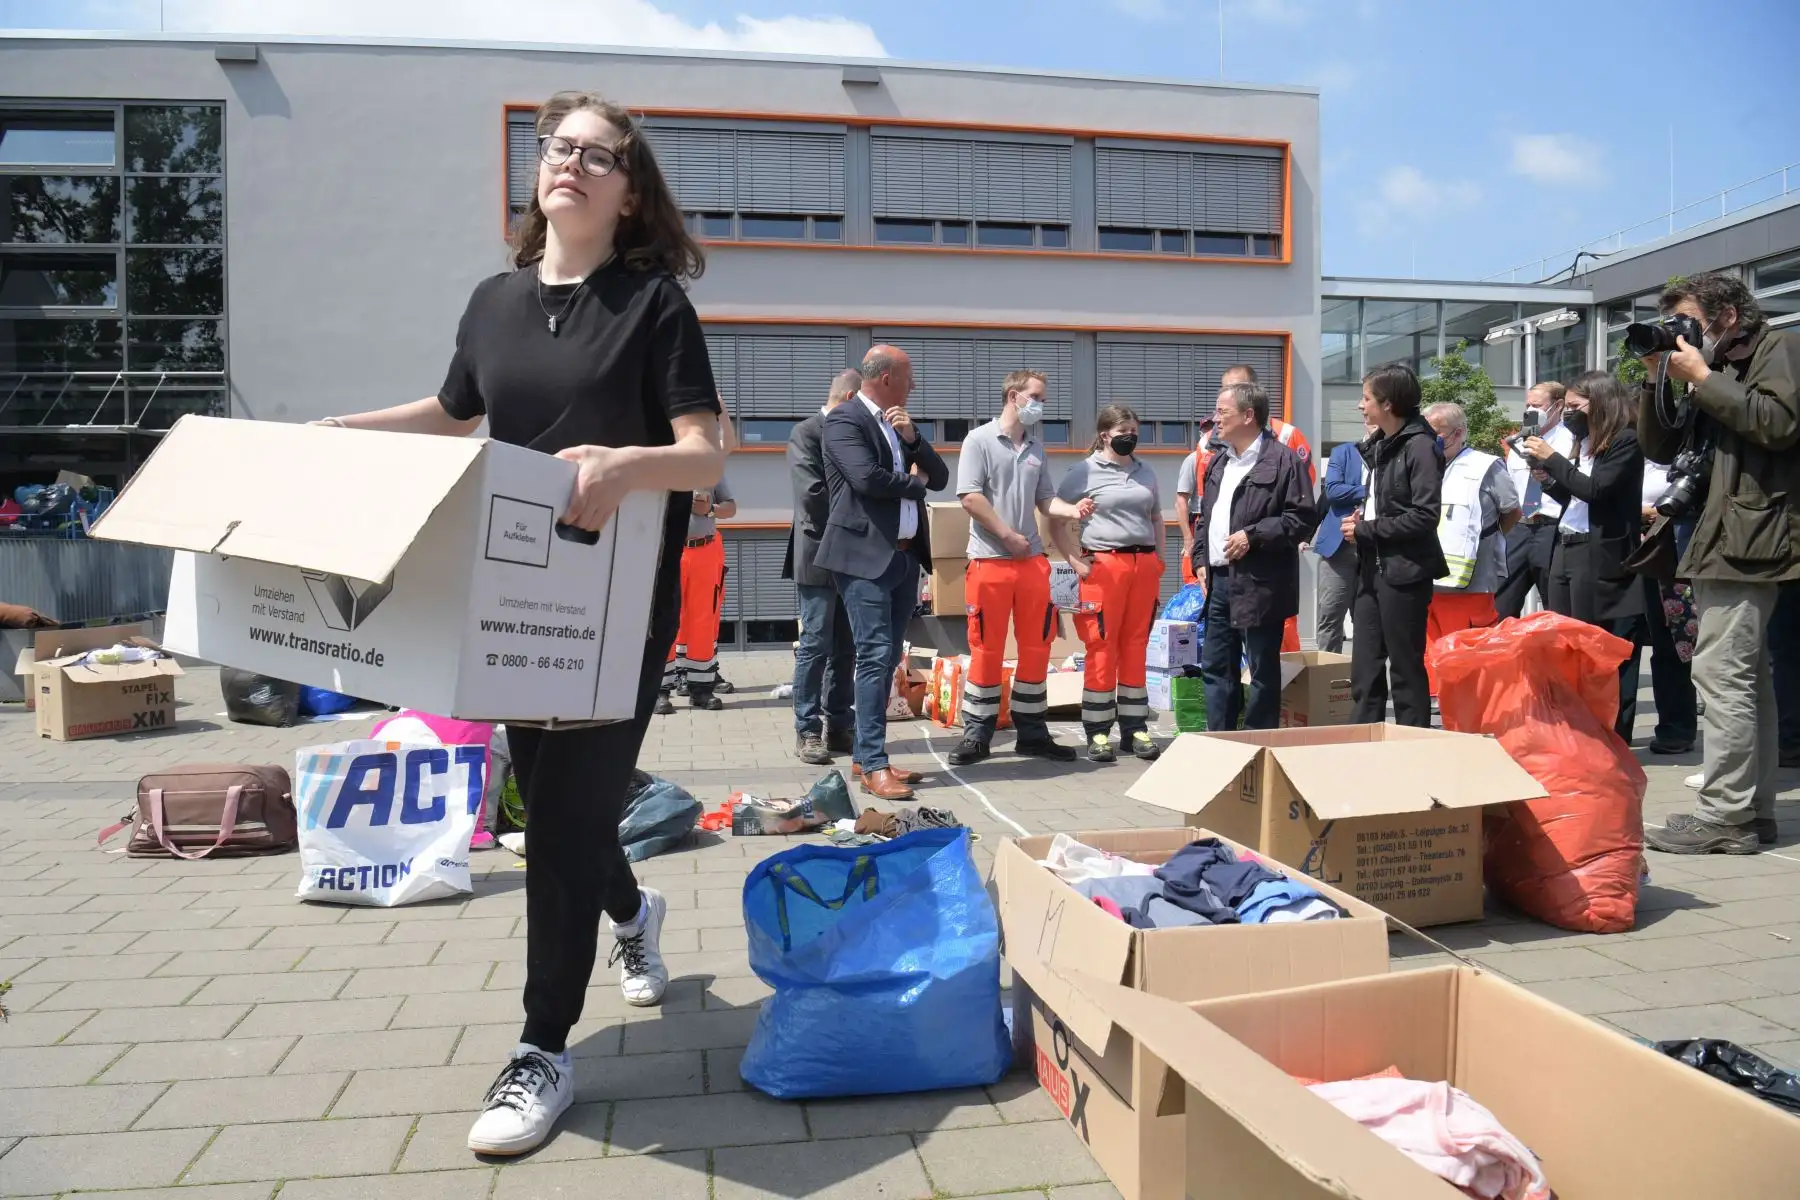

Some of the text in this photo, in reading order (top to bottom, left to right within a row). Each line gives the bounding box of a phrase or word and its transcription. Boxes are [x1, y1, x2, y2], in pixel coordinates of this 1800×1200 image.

[515, 522, 528, 531] Für
[503, 531, 536, 544] Aufkleber
[254, 584, 295, 603] Umziehen
[252, 603, 305, 623] mit Verstand
[499, 595, 586, 616] Umziehen mit Verstand
[480, 619, 596, 640] www.transratio.de
[250, 626, 385, 668] www.transratio.de
[502, 654, 528, 667] 0800
[538, 656, 550, 669] 66
[553, 657, 564, 670] 45
[567, 658, 584, 671] 210
[121, 683, 158, 695] STAPEL
[146, 691, 170, 705] FIX
[132, 710, 165, 729] XM
[1420, 839, 1432, 849] 110
[318, 857, 415, 891] ACTION
